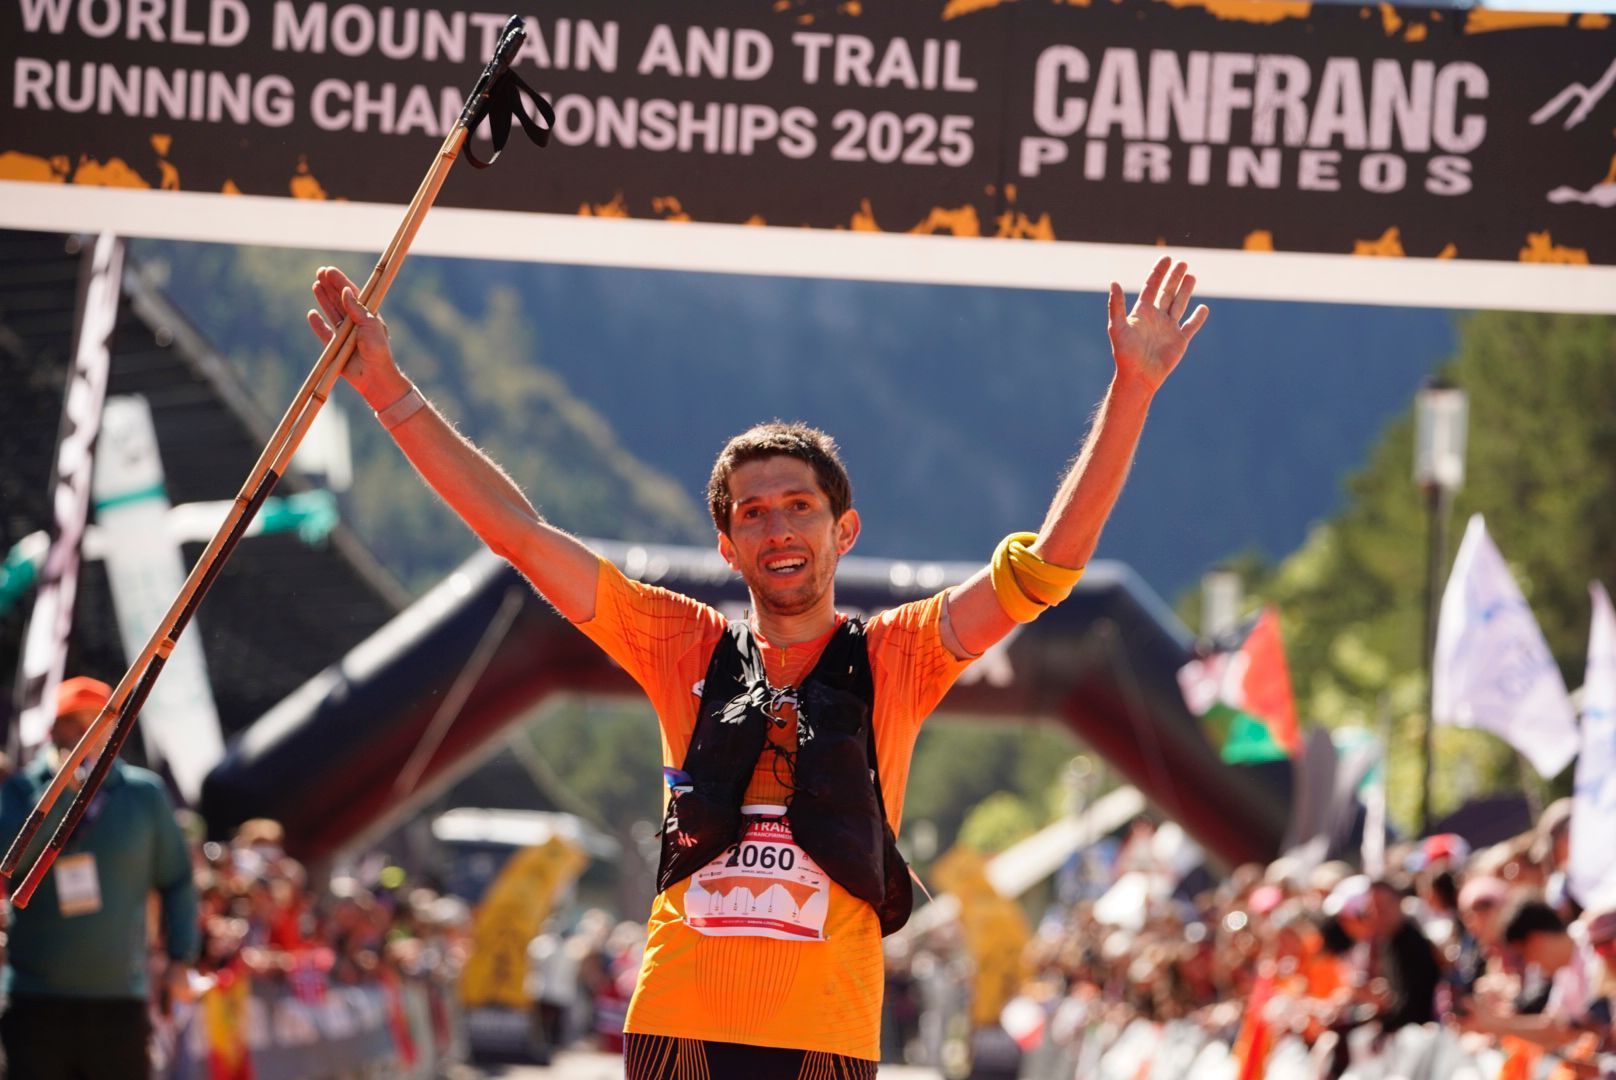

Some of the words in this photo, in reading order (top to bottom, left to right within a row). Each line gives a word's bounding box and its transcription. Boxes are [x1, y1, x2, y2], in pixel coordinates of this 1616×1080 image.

[20, 0, 250, 46] WORLD
[273, 0, 619, 72] MOUNTAIN
[638, 24, 774, 80] AND
[792, 31, 977, 92] TRAIL
[13, 57, 295, 127] RUNNING
[830, 109, 975, 167] 2025
[1033, 45, 1490, 153] CANFRANC
[1019, 136, 1473, 195] PIRINEOS
[725, 844, 795, 871] 2060
